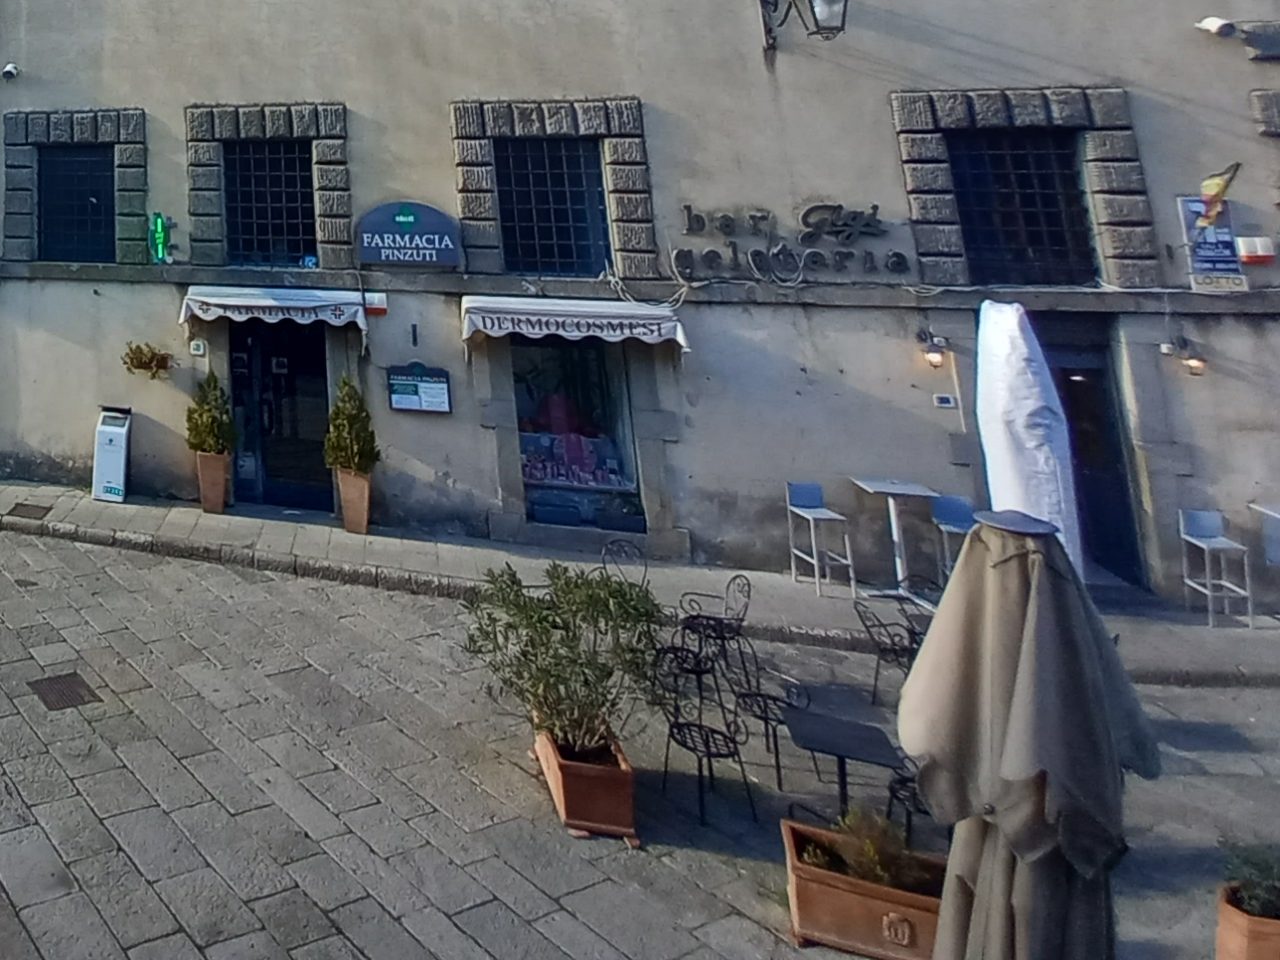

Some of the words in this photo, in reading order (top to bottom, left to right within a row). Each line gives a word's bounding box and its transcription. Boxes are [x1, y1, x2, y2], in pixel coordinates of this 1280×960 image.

[362, 233, 454, 249] FARMACIA
[381, 249, 437, 261] PINZUTI
[222, 305, 319, 318] FARMACIA
[480, 315, 664, 337] DERMOCOSMESI
